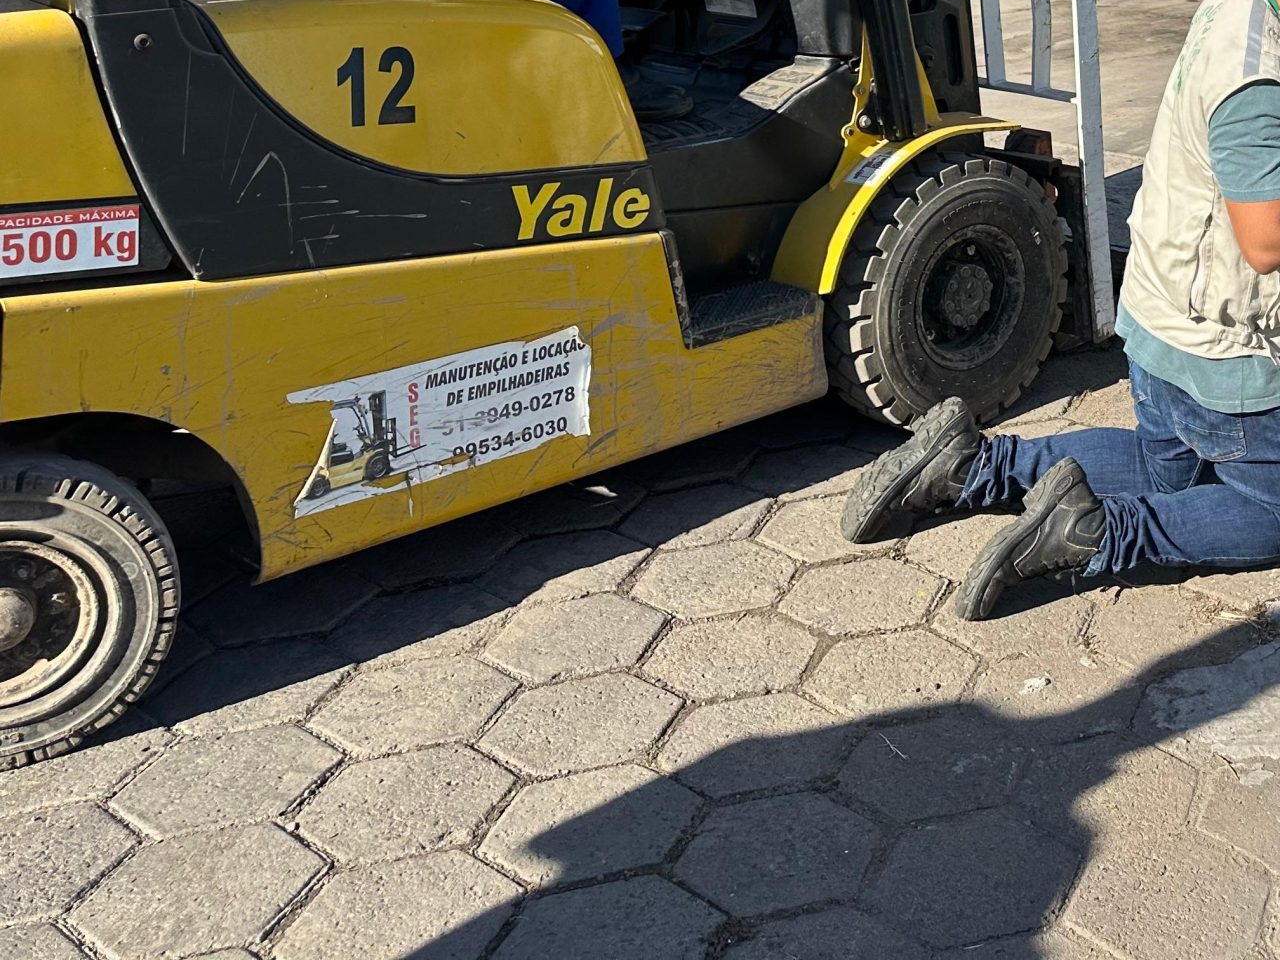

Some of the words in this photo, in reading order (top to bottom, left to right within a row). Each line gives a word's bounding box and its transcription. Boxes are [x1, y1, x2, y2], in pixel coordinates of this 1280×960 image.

[336, 46, 416, 127] 12
[79, 209, 136, 222] MÁXIMA
[511, 177, 650, 240] Yale
[2, 228, 77, 266] 500
[94, 226, 136, 262] kg
[521, 350, 530, 365] E
[446, 390, 464, 407] DE
[467, 361, 570, 401] EMPILHADEIRAS
